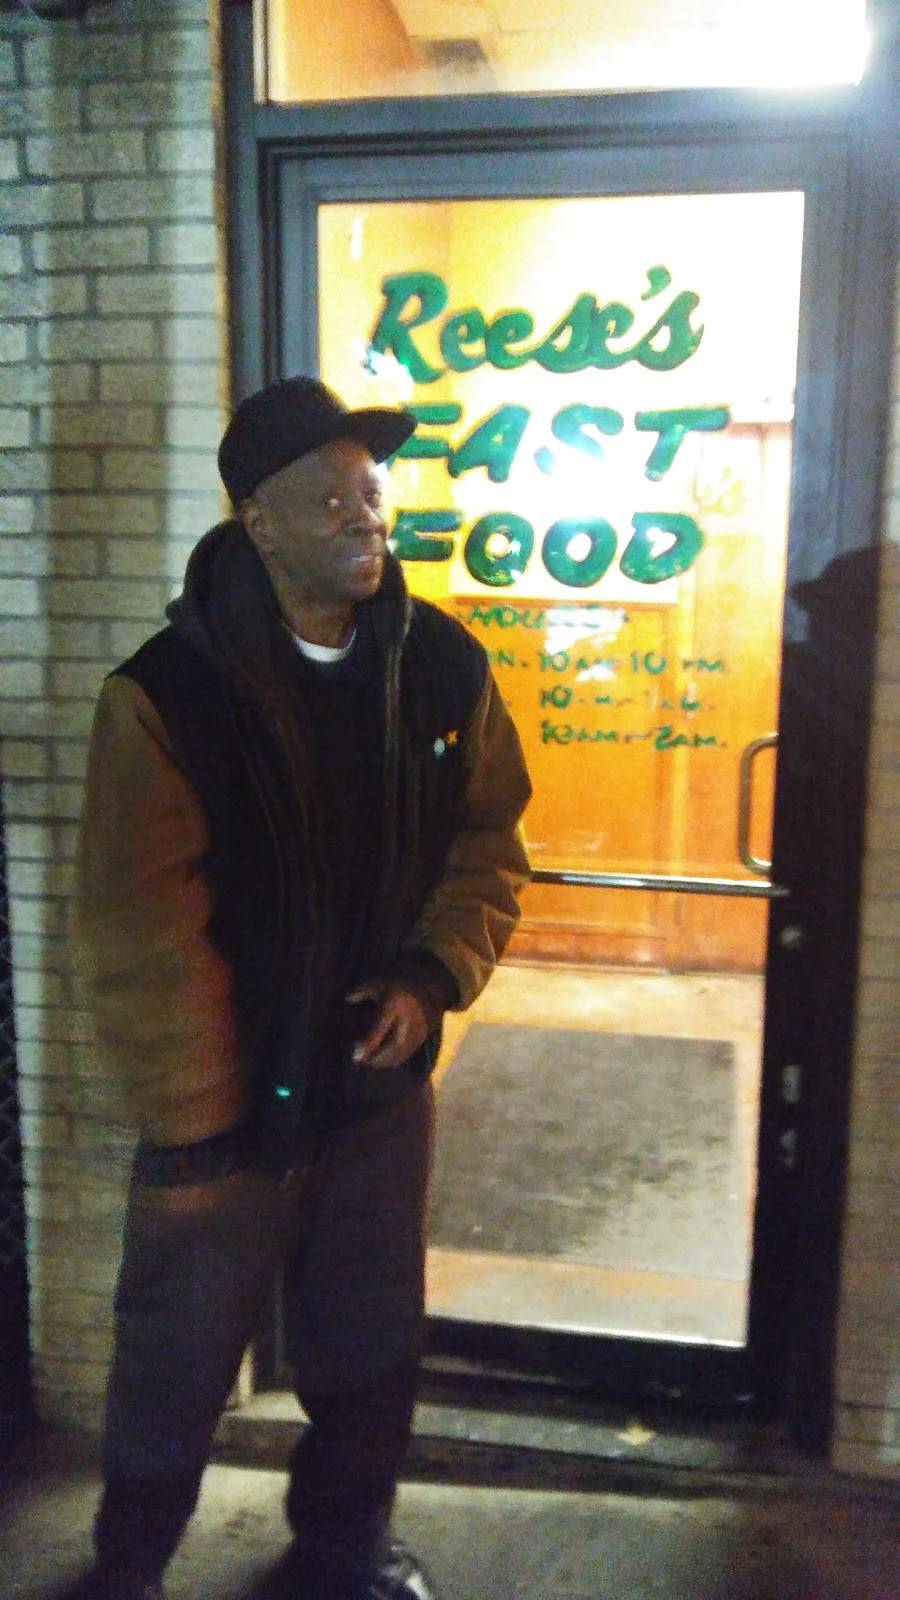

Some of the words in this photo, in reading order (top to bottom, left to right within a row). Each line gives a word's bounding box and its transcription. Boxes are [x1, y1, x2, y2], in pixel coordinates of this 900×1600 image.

[364, 264, 705, 383] Reese's
[389, 402, 731, 484] FAST
[389, 509, 705, 588] FOOD
